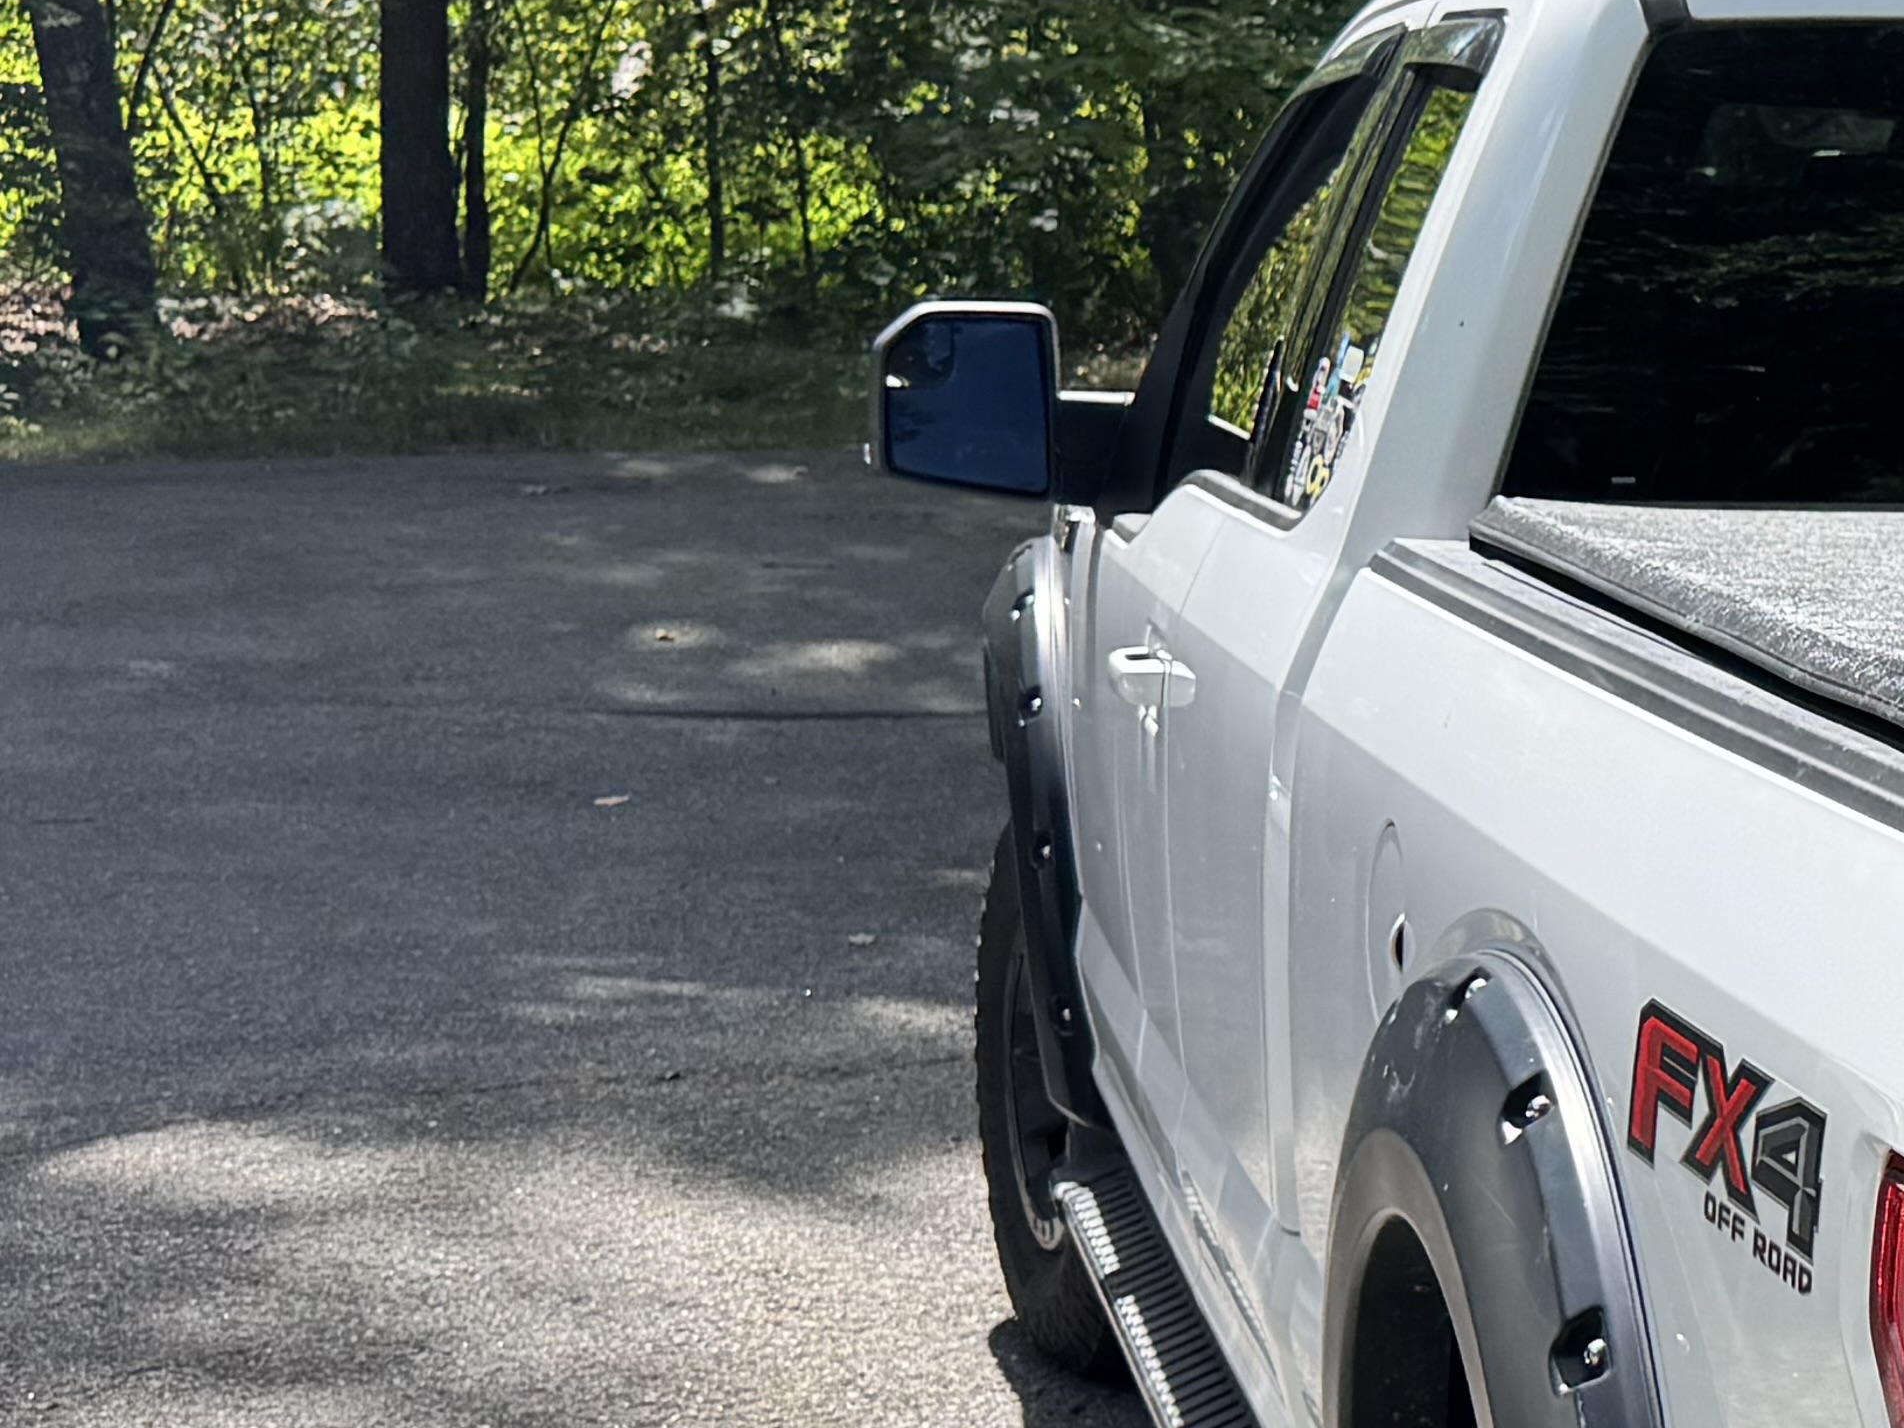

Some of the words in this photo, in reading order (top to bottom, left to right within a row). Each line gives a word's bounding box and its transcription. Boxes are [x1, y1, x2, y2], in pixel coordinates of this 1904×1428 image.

[1626, 996, 1829, 1266] FX4
[1703, 1191, 1747, 1243] OFF
[1752, 1227, 1813, 1296] ROAD
